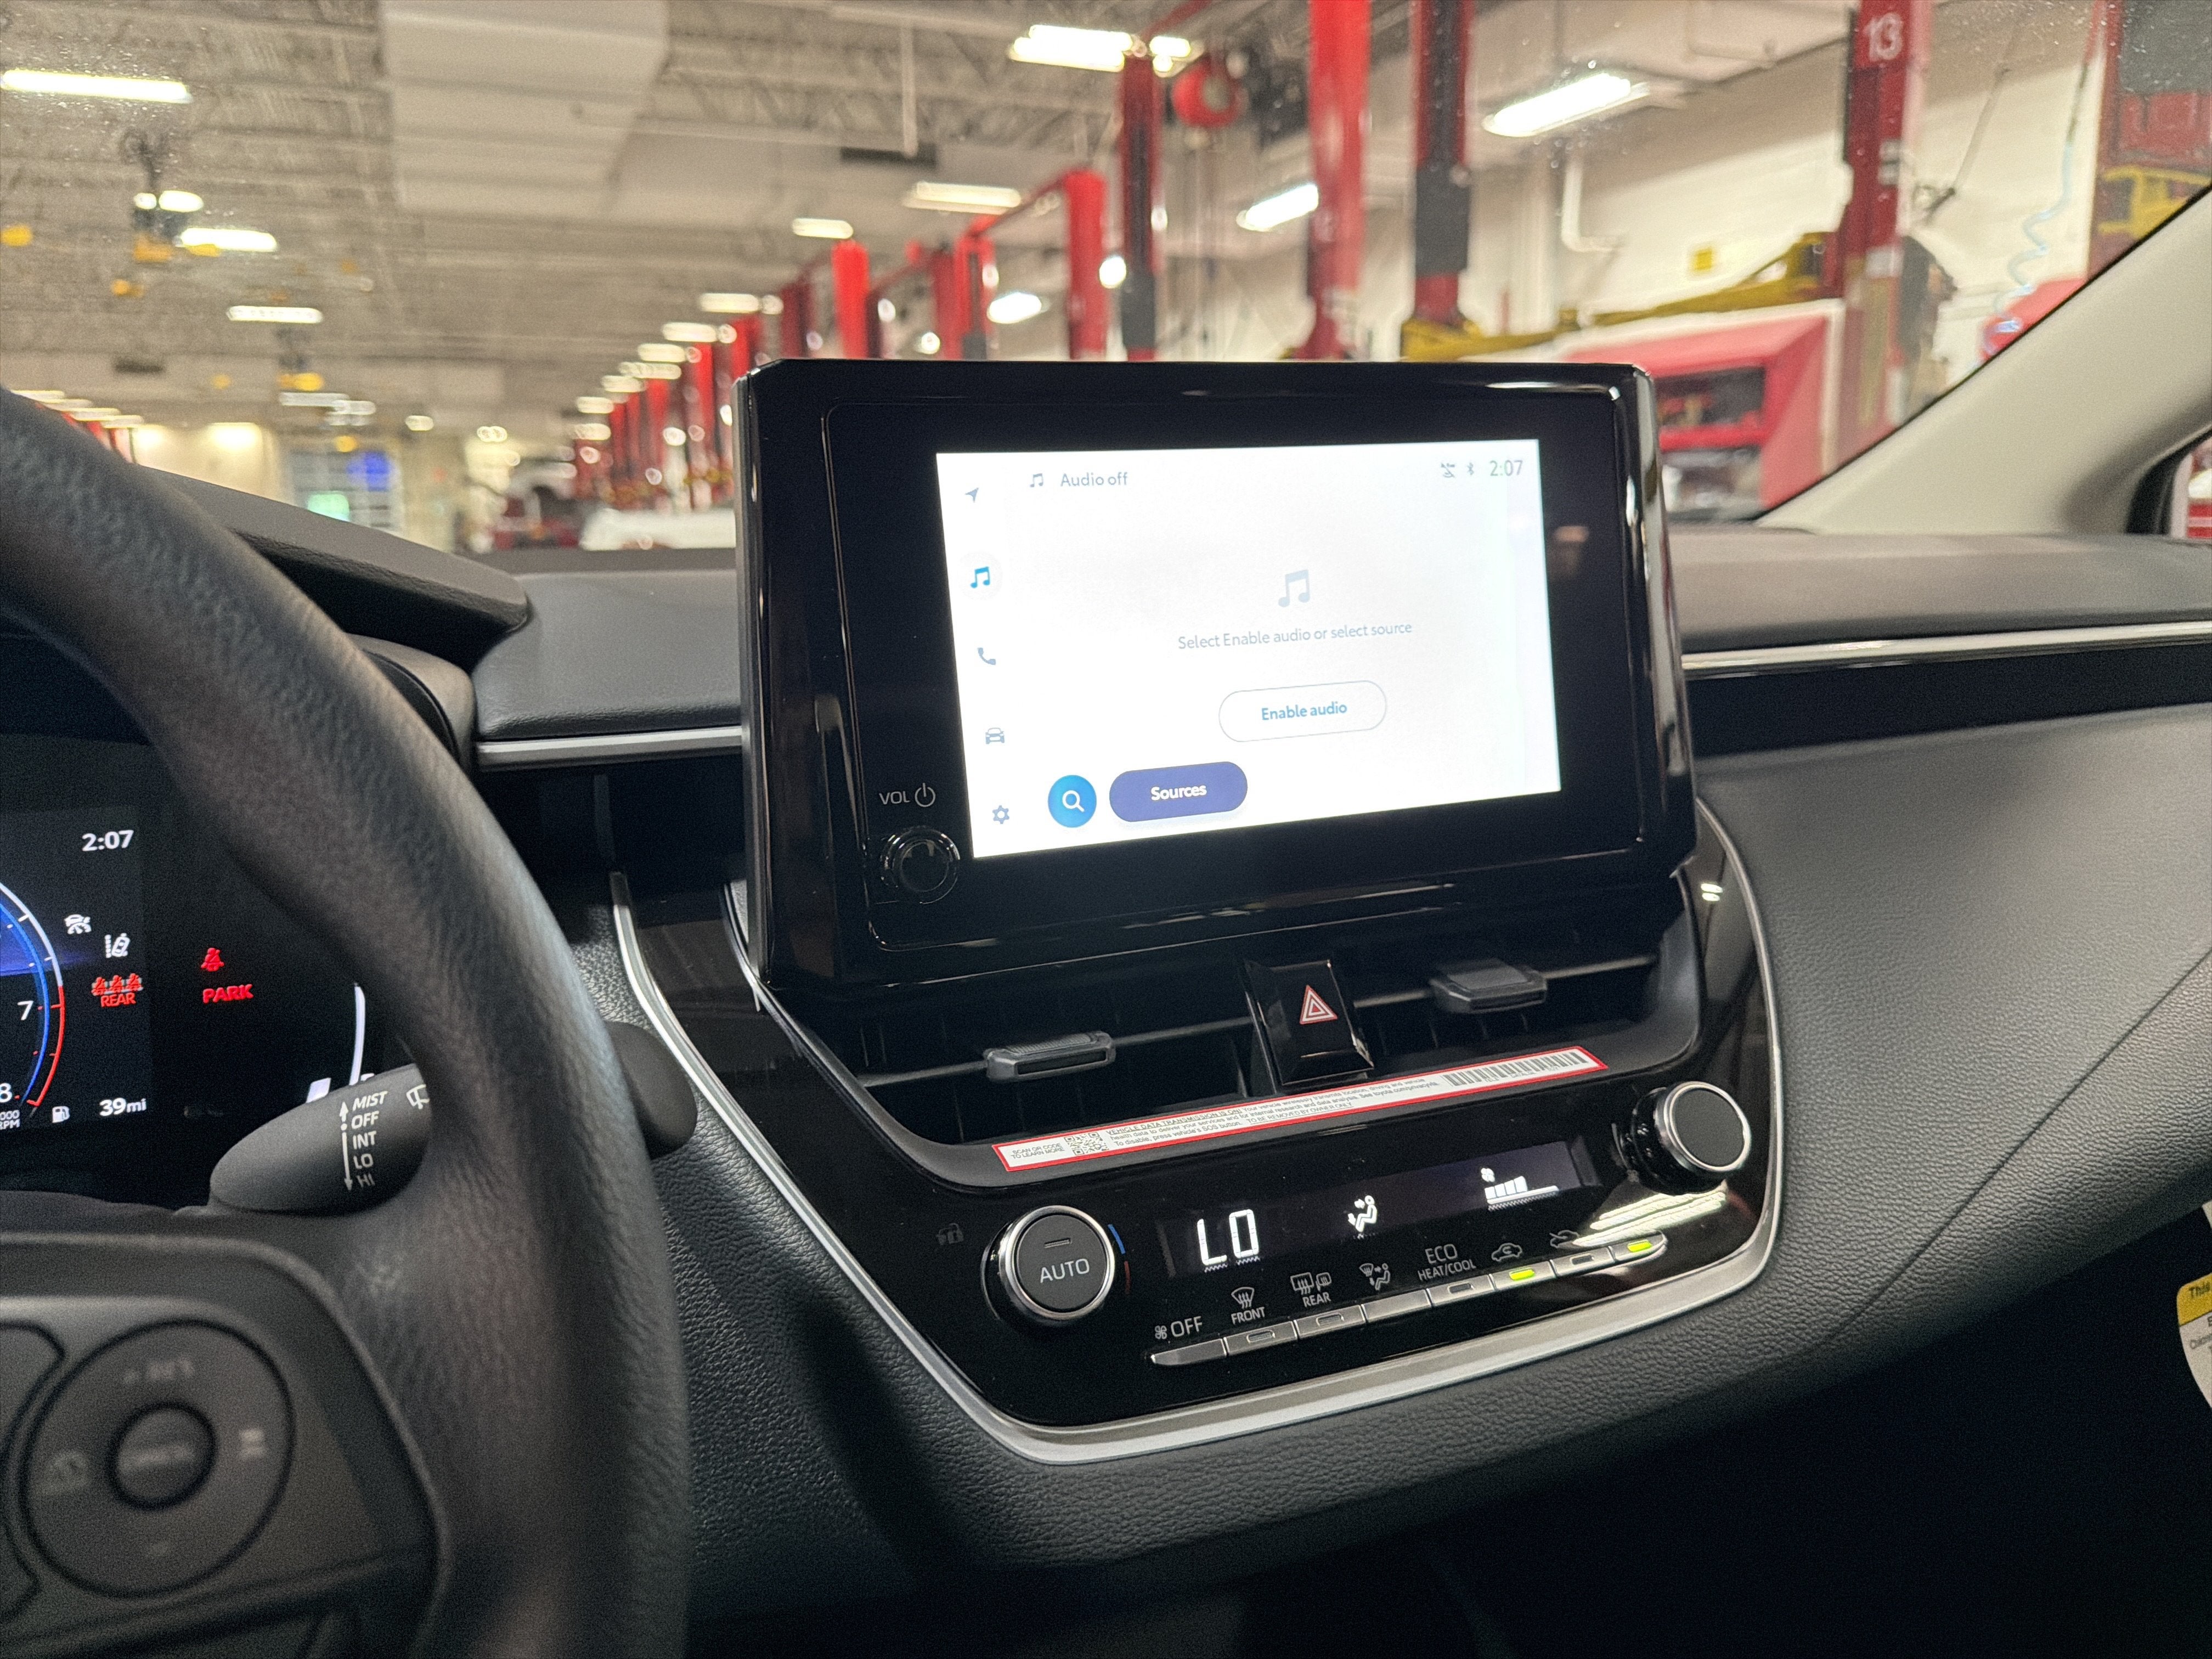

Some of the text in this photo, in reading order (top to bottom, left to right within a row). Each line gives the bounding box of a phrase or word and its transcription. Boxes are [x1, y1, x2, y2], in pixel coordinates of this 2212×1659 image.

[1866, 12, 1904, 62] 13
[1489, 460, 1523, 476] 2:07
[1060, 472, 1128, 487] Audio off
[1178, 624, 1413, 650] Select Enable audio or select source
[1261, 701, 1348, 720] Enable audio
[879, 791, 910, 806] VOL
[1150, 785, 1207, 802] Sources
[82, 830, 134, 851] 2:07
[100, 992, 136, 1007] REAR
[202, 984, 253, 1003] PARK
[17, 1000, 34, 1020] 7
[352, 1091, 388, 1111] MIST
[351, 1110, 379, 1129] OFF
[1106, 1126, 1141, 1135] VEHICLE
[1161, 1113, 1218, 1125] TRANSMISSION
[1124, 1136, 1152, 1145] disable,
[1172, 1127, 1201, 1136] vehicle's
[1267, 1111, 1300, 1119] REMOVED
[353, 1130, 376, 1149] INT
[353, 1153, 374, 1169] LO
[357, 1173, 375, 1188] HI
[1197, 1209, 1259, 1266] LO
[1425, 1244, 1457, 1265] ECO
[1040, 1259, 1090, 1283] AUTO
[1418, 1260, 1476, 1281] HEAT/COOL
[1302, 1291, 1331, 1307] REAR
[1231, 1307, 1265, 1324] FRONT
[1171, 1316, 1203, 1338] OFF
